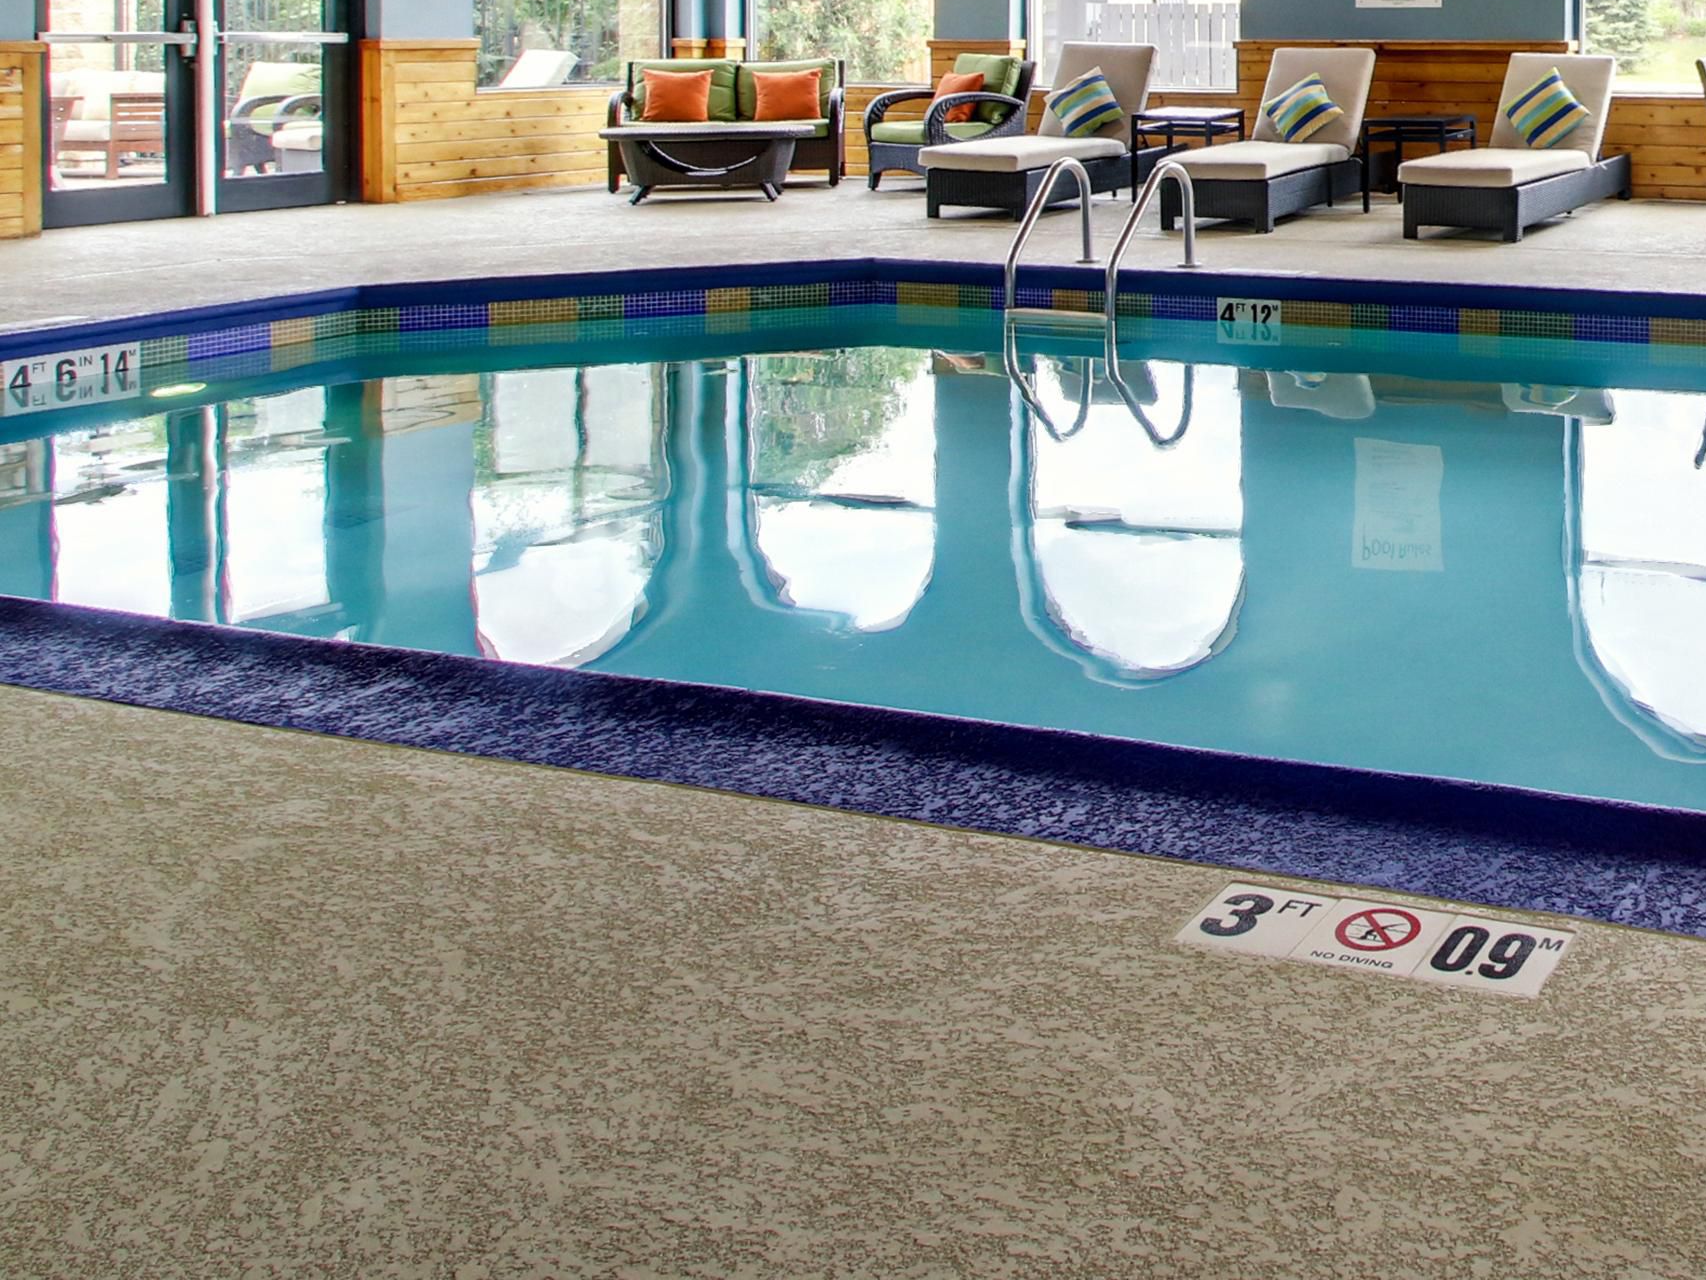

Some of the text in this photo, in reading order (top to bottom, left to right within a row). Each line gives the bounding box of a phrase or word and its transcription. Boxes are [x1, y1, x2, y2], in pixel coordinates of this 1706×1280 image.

[1220, 302, 1236, 322] 4
[1236, 302, 1246, 313] FT
[9, 364, 32, 389] 4
[32, 361, 47, 373] FT
[56, 358, 77, 382] 6
[79, 354, 93, 367] IN
[128, 349, 137, 357] M
[1200, 894, 1322, 936] 3 FT
[1310, 950, 1394, 969] NO DIVING
[1430, 926, 1564, 979] 0.9 M
